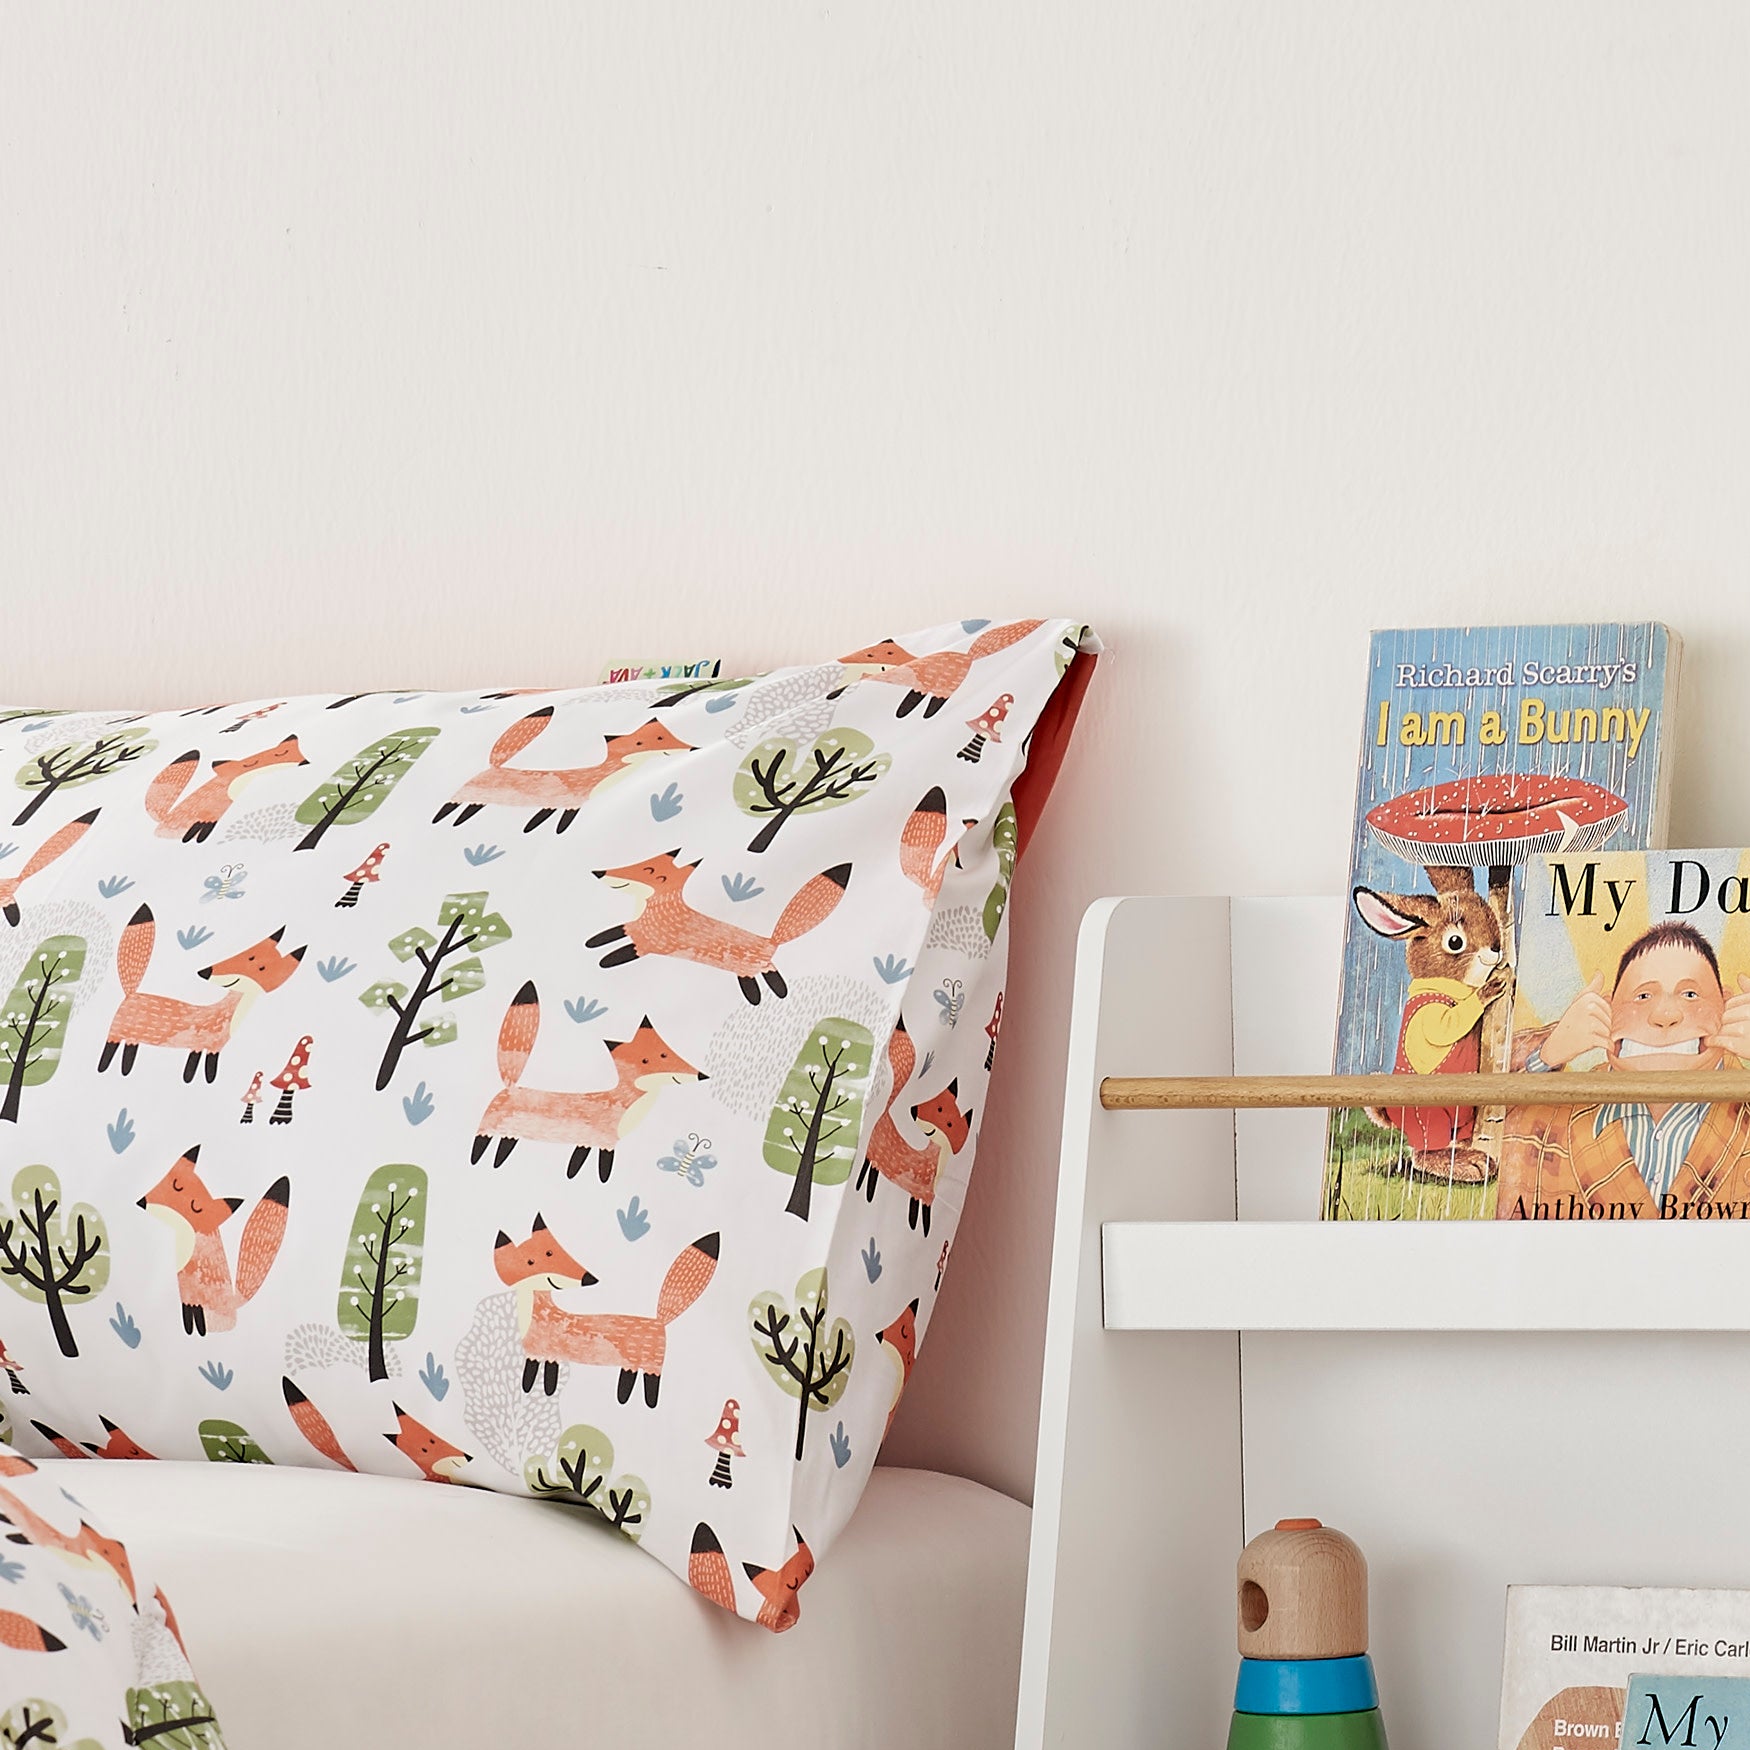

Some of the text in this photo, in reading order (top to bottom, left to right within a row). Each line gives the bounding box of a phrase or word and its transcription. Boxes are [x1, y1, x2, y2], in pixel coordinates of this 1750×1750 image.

[610, 666, 643, 683] AVA
[1396, 657, 1637, 689] Richard Scarry's
[1376, 697, 1650, 758] I am a Bunny
[1545, 862, 1637, 932] My
[1551, 1635, 1578, 1652] Bill
[1583, 1636, 1637, 1654] Martin
[1642, 1638, 1660, 1655] Jr
[1675, 1639, 1709, 1656] Eric
[1554, 1719, 1609, 1738] Brown
